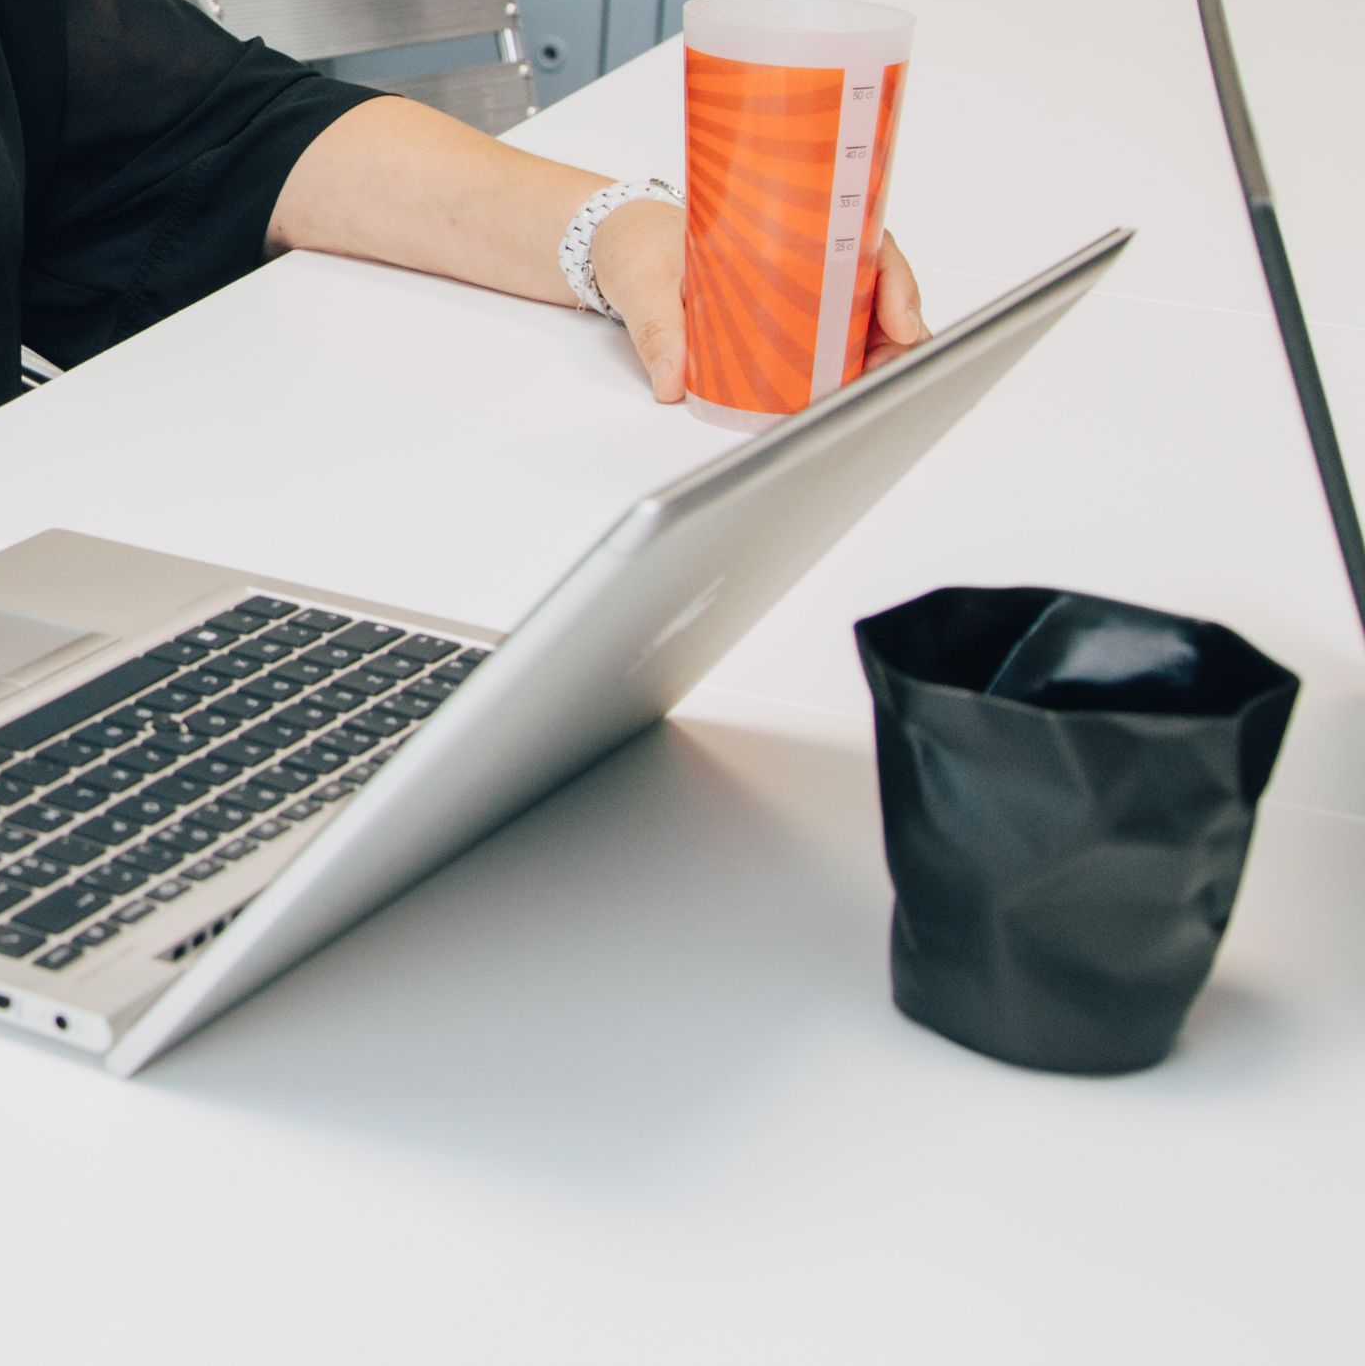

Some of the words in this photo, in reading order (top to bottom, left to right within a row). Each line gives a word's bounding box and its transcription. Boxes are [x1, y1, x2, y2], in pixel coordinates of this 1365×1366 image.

[852, 91, 864, 100] 50
[865, 90, 874, 99] cl
[845, 151, 856, 160] 40
[858, 150, 866, 159] cl
[840, 199, 850, 208] 33
[852, 199, 860, 207] cl
[835, 242, 845, 251] 25
[846, 242, 854, 250] cl
